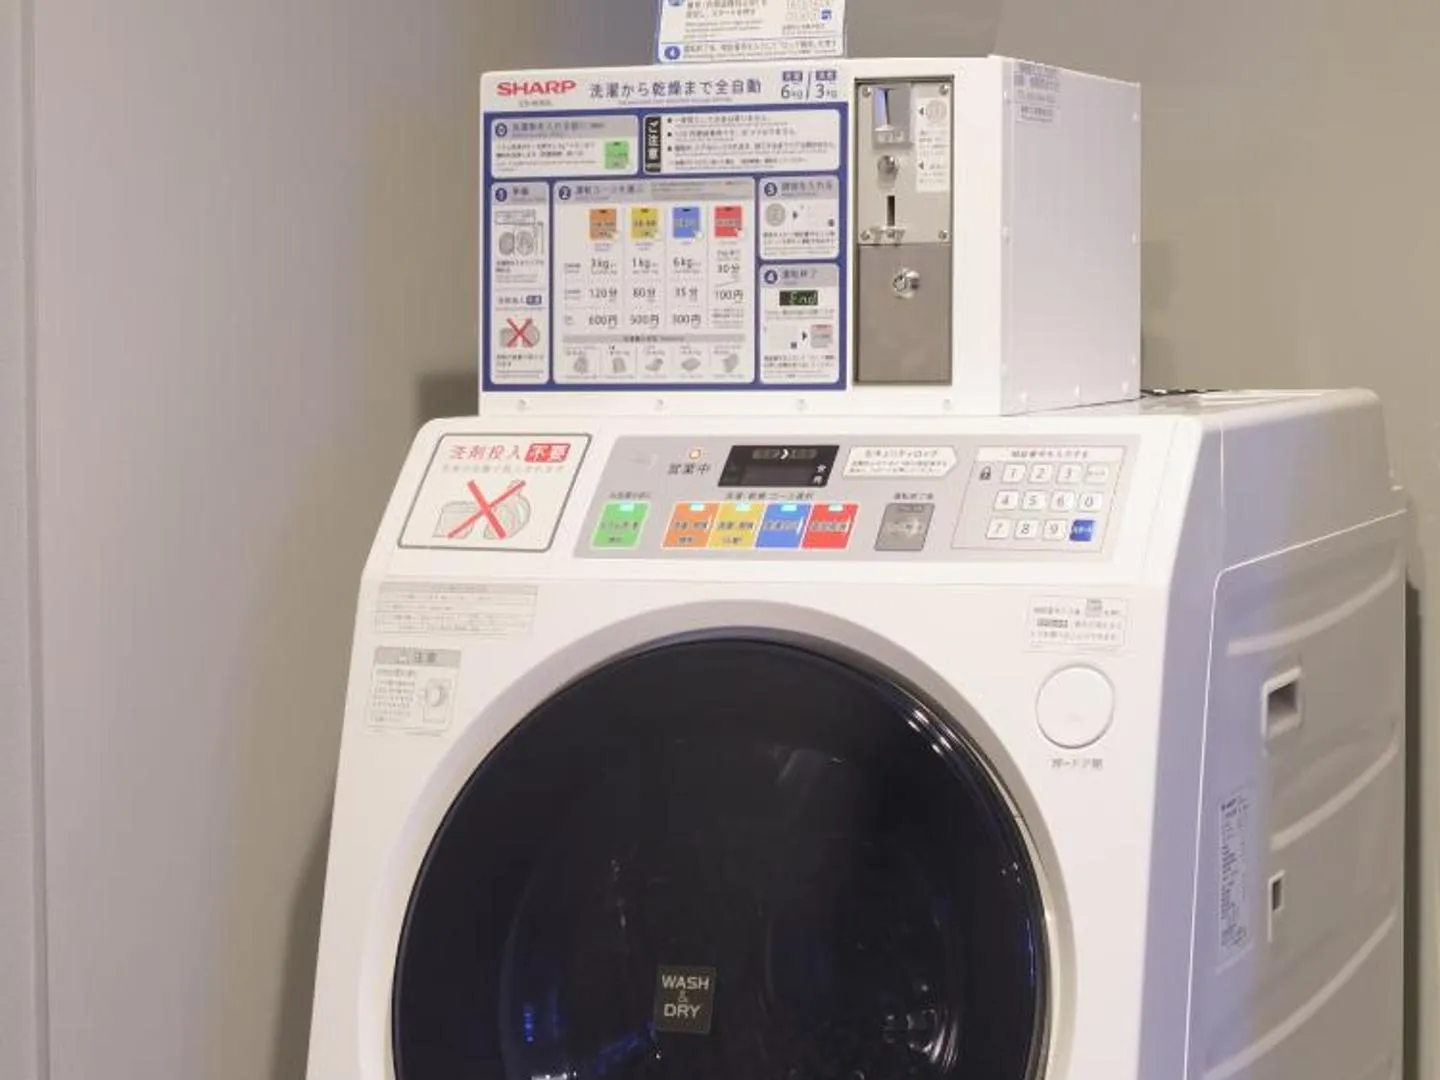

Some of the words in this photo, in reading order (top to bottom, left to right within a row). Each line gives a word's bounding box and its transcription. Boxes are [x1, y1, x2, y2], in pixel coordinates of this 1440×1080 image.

[496, 79, 577, 97] SHARP
[590, 78, 762, 99] 洗濯から乾燥まで全自動
[661, 974, 710, 990] WASH
[663, 1003, 702, 1019] DRY
